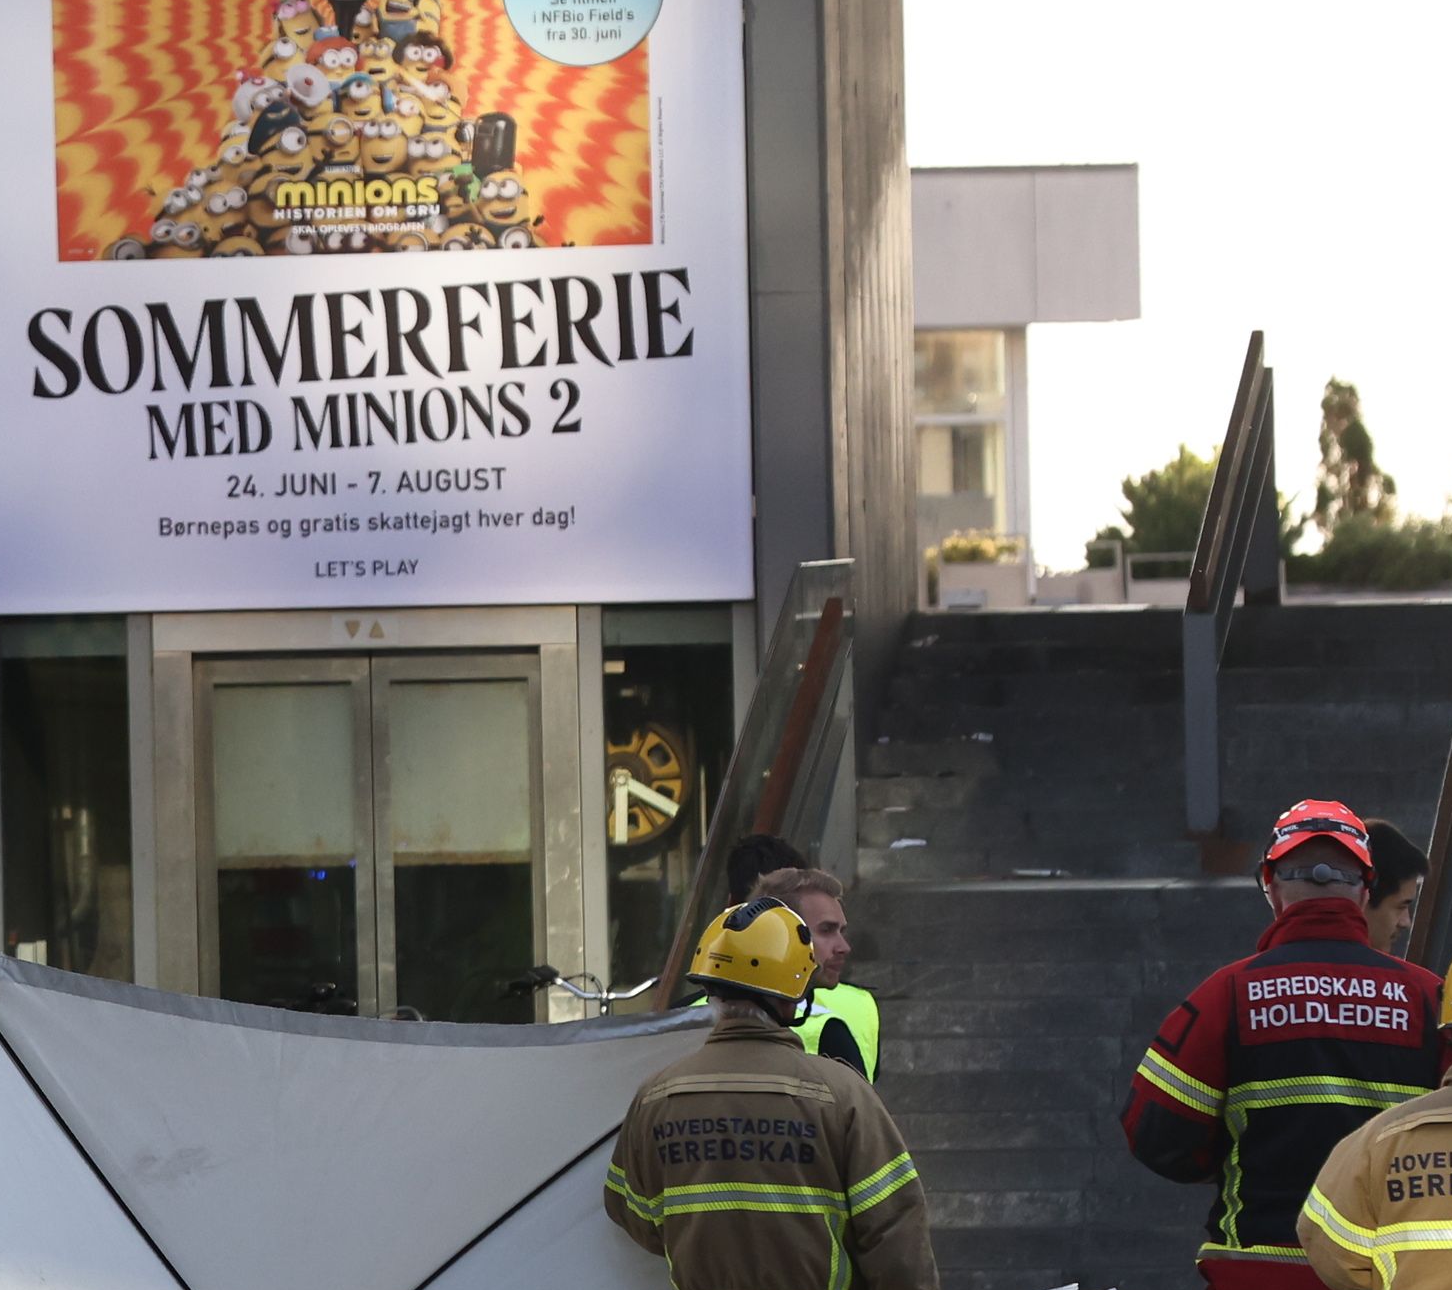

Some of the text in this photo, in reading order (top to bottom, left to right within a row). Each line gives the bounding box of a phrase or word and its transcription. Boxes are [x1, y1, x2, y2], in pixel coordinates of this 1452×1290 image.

[542, 9, 584, 23] NFBio
[589, 7, 635, 21] Field's
[547, 26, 622, 43] fra 30. juni
[273, 204, 441, 220] HISTORIEN OM GRU
[292, 225, 317, 234] SKAL
[368, 222, 426, 232] BIOGRAFEN
[27, 267, 695, 400] SOMMERFERIE
[146, 377, 582, 461] MED MINIONS 2
[226, 473, 266, 499] 24.
[274, 472, 338, 498] JUNI
[367, 471, 388, 496] 7.
[395, 467, 506, 495] AUGUST
[158, 506, 577, 540] Børnepas og gratis skattejagt hver dag!
[314, 559, 420, 578] LET'S PLAY
[1247, 975, 1409, 1004] BEREDSKAB 4K
[1249, 1000, 1410, 1033] HOLDLEDER
[653, 1117, 817, 1140] HOVEDSTADENS
